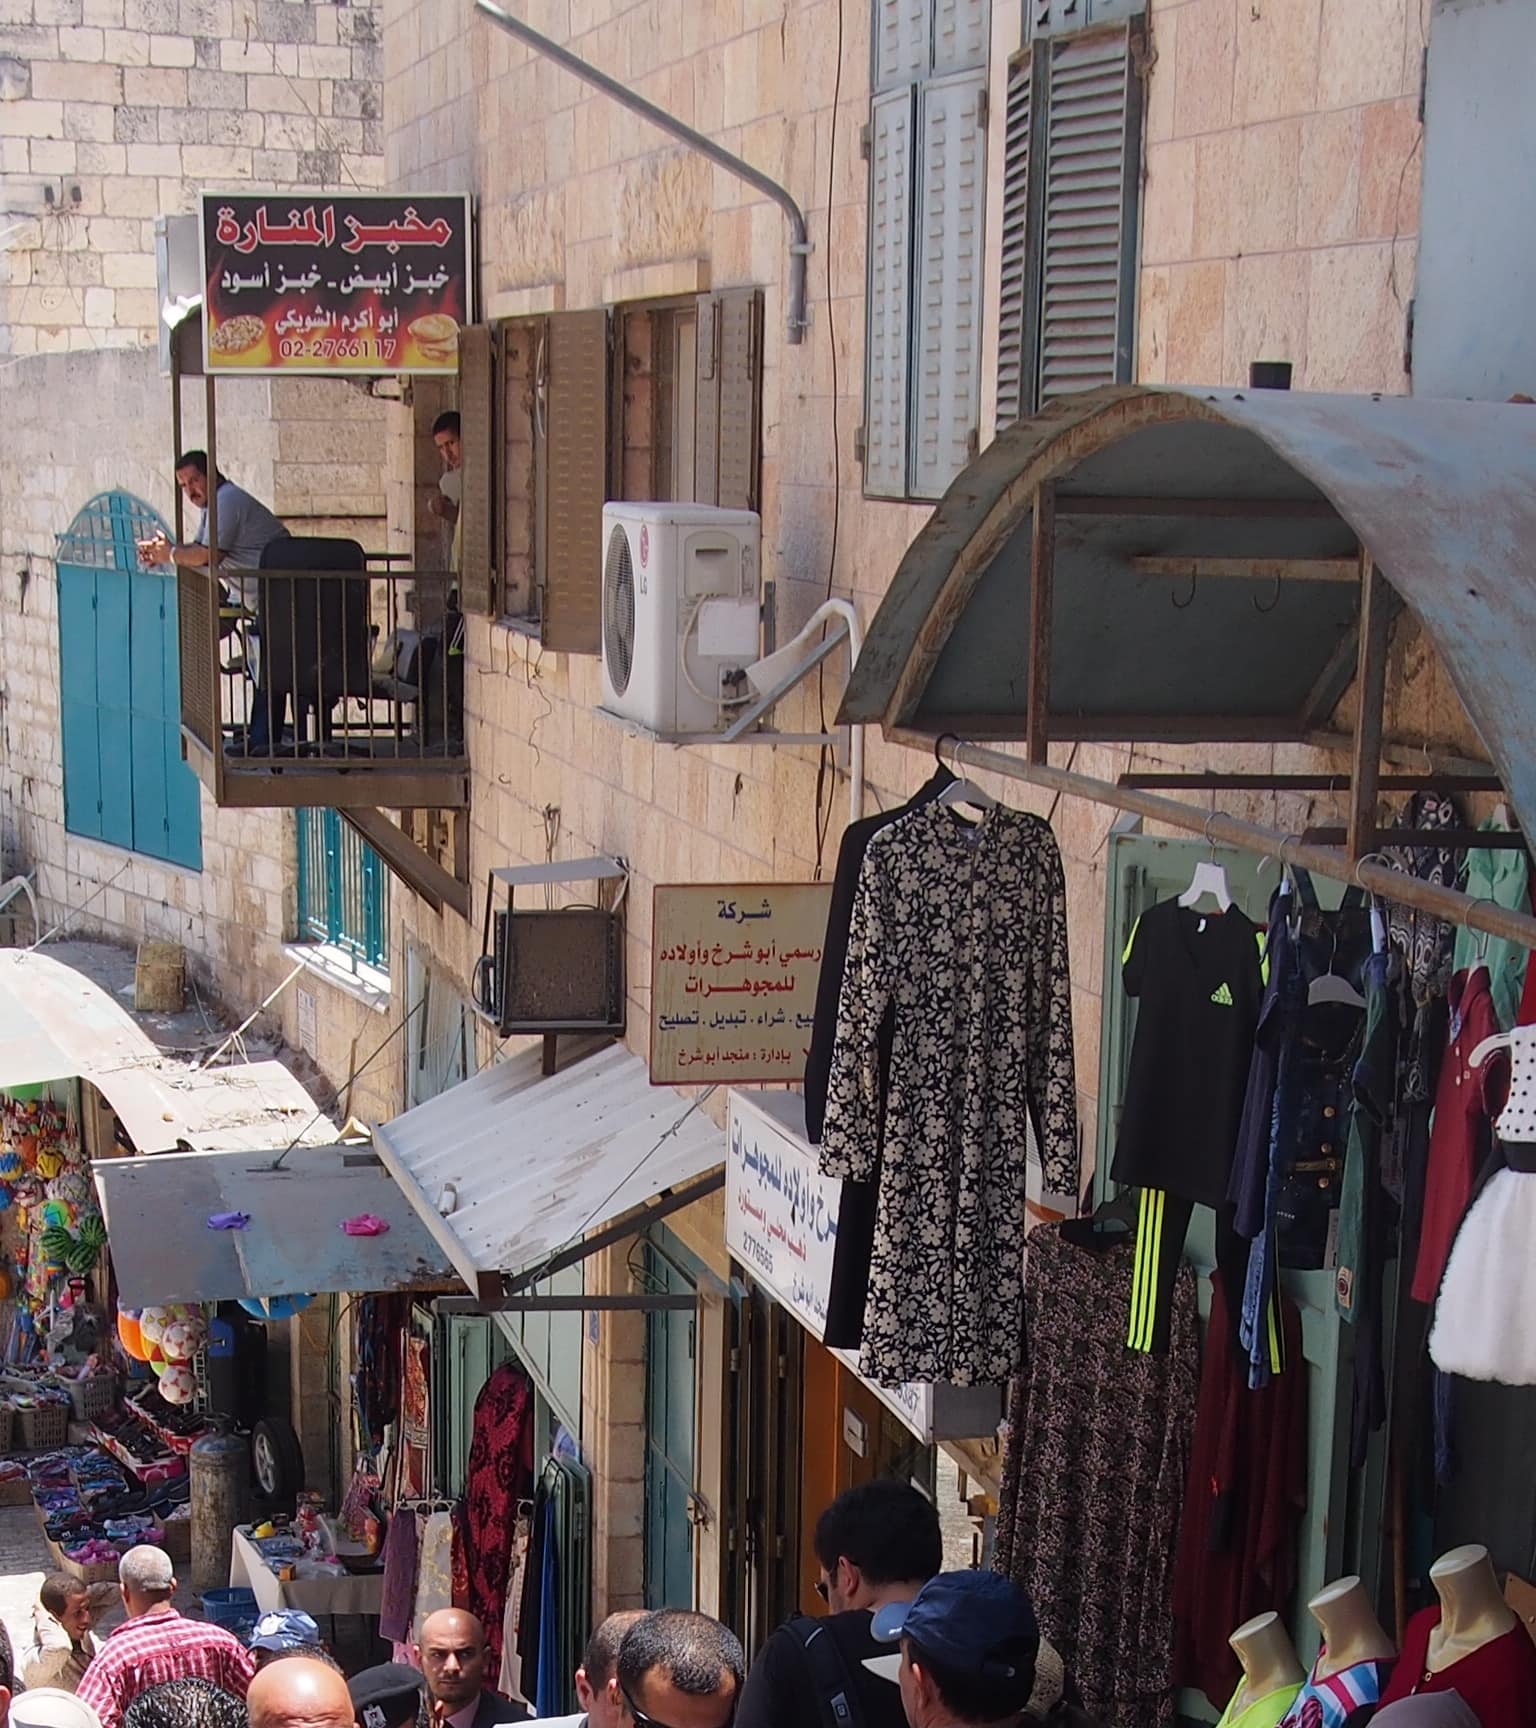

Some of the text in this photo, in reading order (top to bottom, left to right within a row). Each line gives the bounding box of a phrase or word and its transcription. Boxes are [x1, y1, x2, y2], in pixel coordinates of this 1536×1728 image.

[216, 204, 453, 255] مخبز المنارة
[221, 261, 271, 295] أسود
[277, 262, 321, 295] خبز
[340, 261, 399, 295] أبيض
[402, 263, 450, 295] خبز
[378, 306, 400, 335] أبو
[279, 338, 397, 359] 02-2766117
[717, 898, 772, 924] شركة
[711, 940, 753, 967] شرخ
[755, 938, 776, 966] أبو
[779, 947, 822, 968] رسمي
[684, 975, 795, 998] للمجوهرات
[658, 1009, 700, 1031] تصليح
[709, 1009, 747, 1030] تبديل
[756, 1007, 786, 1028] شراء
